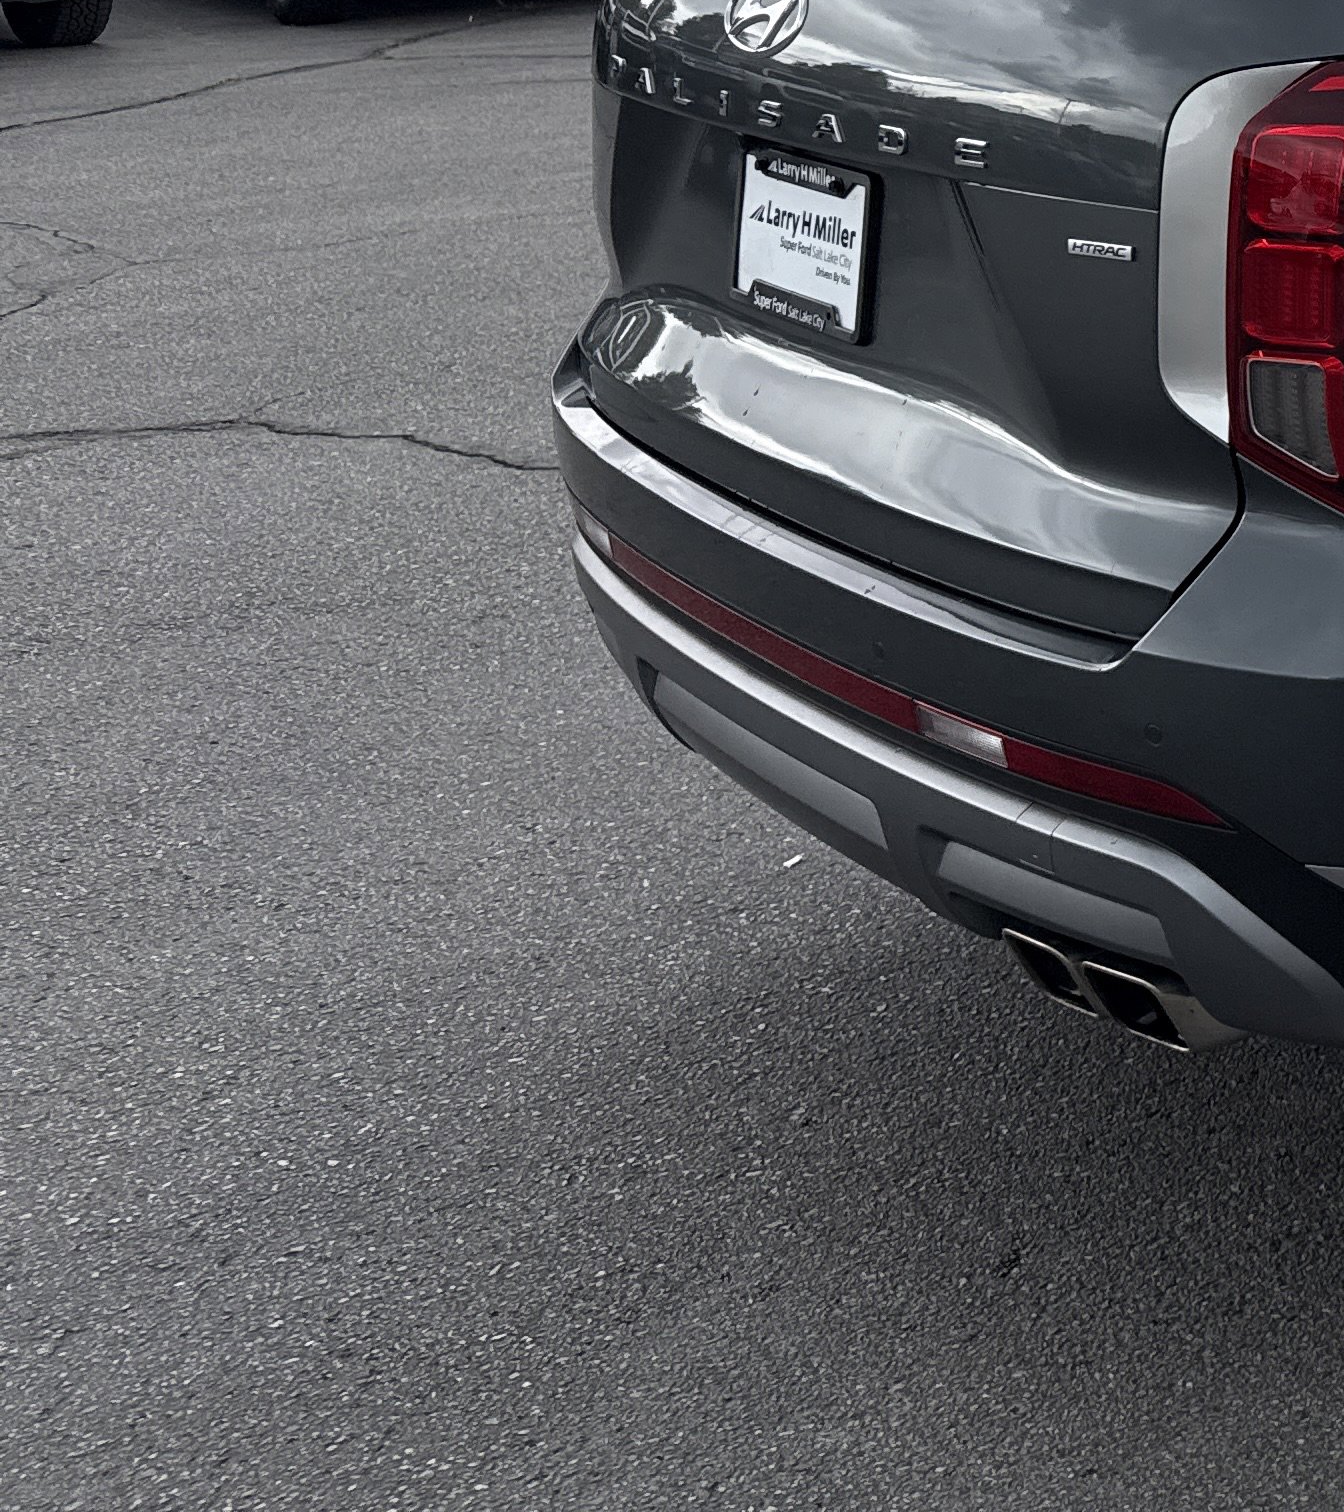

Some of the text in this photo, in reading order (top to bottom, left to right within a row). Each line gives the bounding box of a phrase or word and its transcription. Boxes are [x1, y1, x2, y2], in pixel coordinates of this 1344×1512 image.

[610, 54, 990, 169] PALISADE
[777, 157, 800, 183] Larry
[800, 163, 809, 182] H
[766, 200, 857, 250] Larry H Miller
[779, 235, 798, 253] Super
[797, 240, 813, 257] Ford
[823, 250, 839, 265] Lake
[839, 253, 853, 273] City
[1071, 241, 1127, 258] HTRAC
[753, 290, 773, 311] Super
[772, 295, 788, 316] Ford
